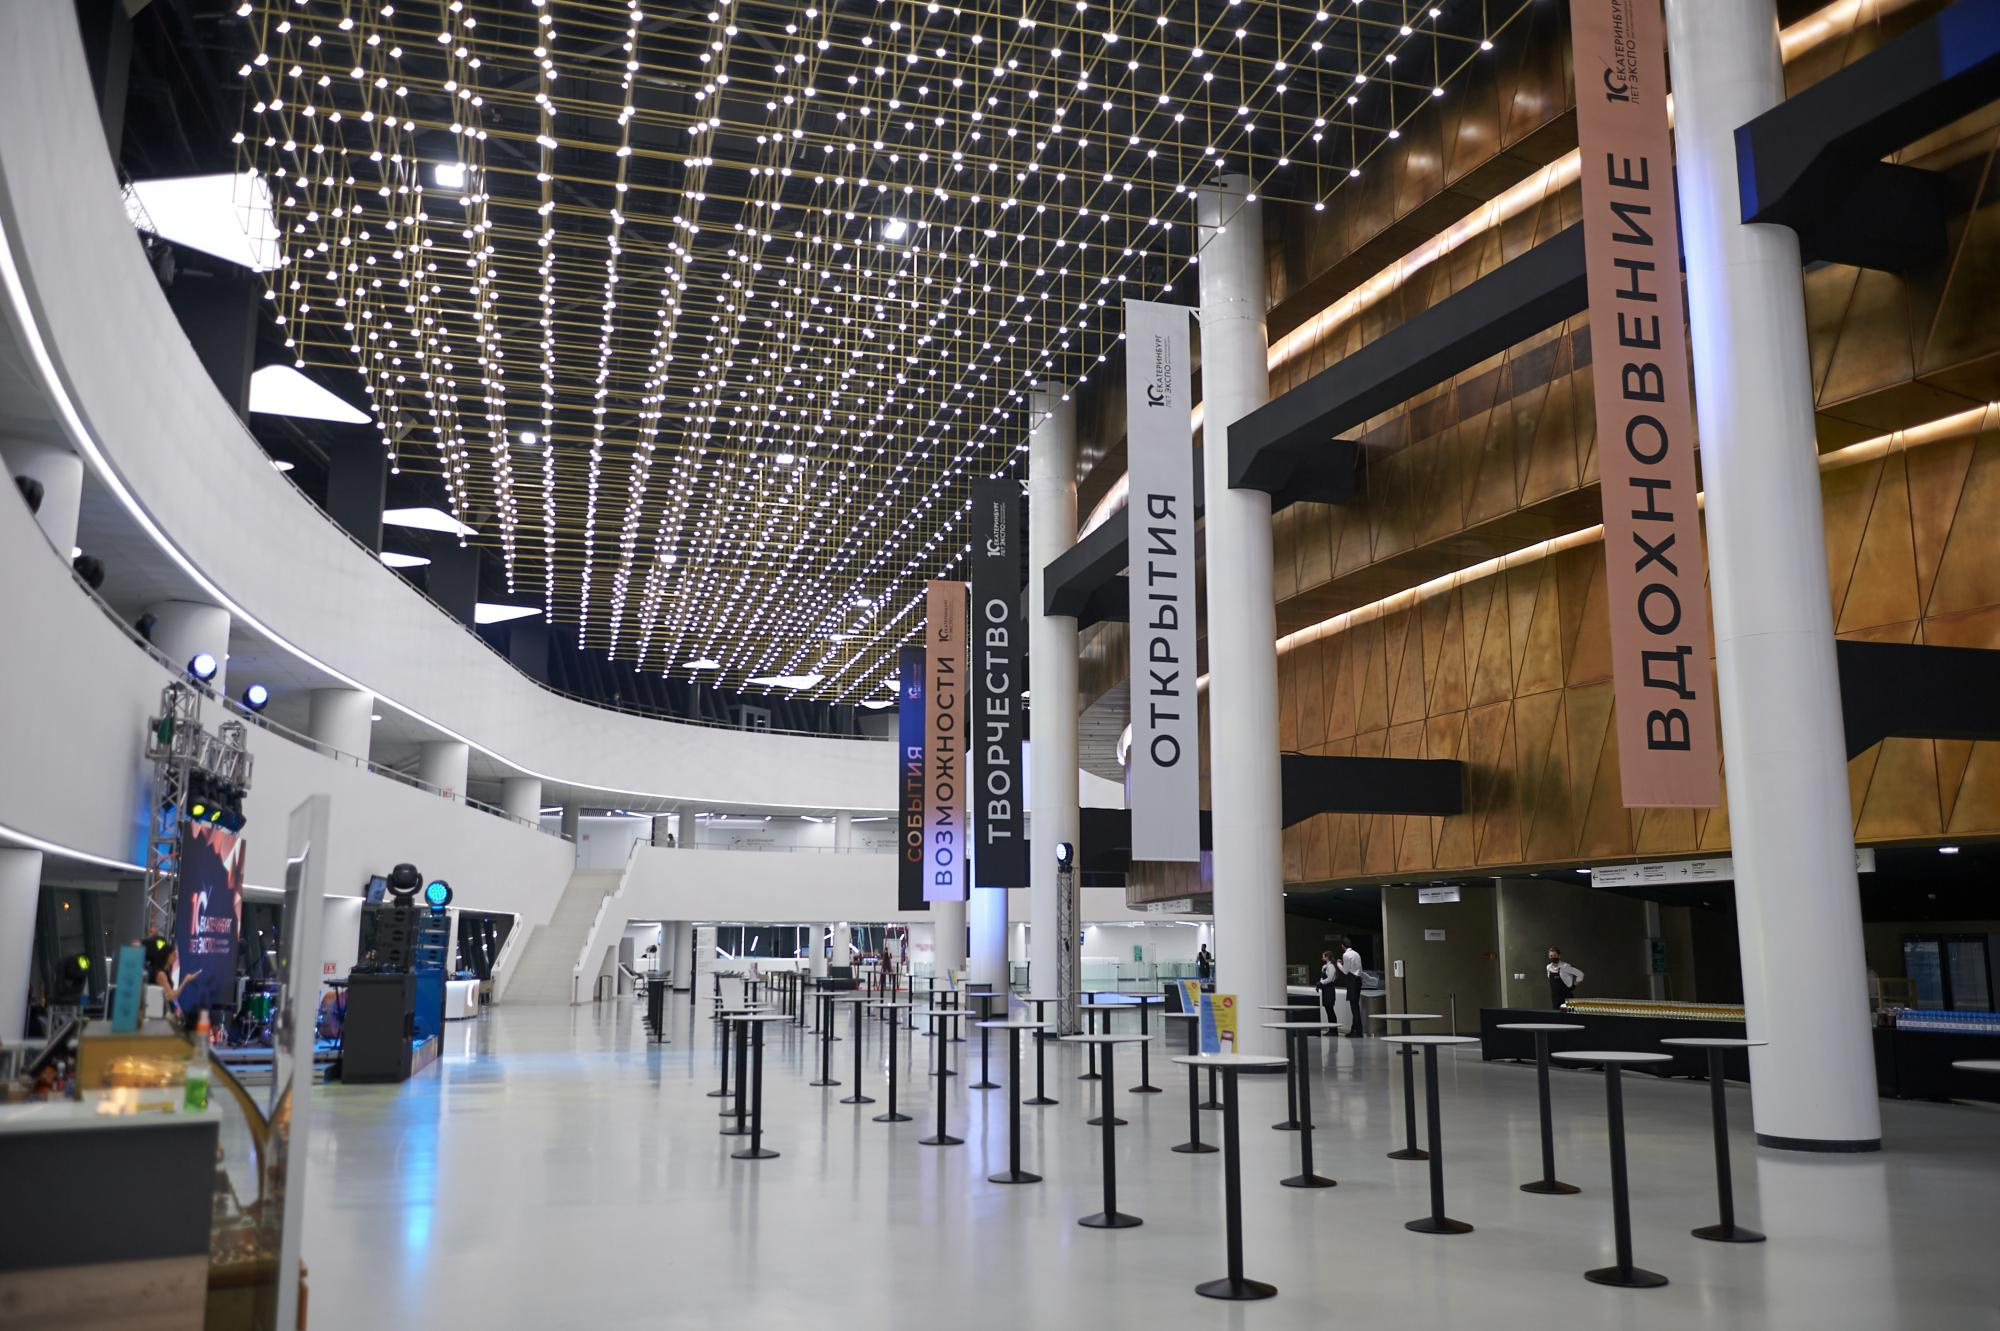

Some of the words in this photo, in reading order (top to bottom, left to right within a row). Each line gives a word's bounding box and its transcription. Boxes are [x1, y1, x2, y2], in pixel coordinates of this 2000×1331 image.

[1626, 39, 1639, 83] ЭКСПО
[1631, 84, 1640, 105] ЛЕТ
[1155, 334, 1164, 393] ЕКАТЕРИНБУРГ
[1164, 364, 1172, 393] ЭКСПО
[1606, 152, 1697, 752] ВДОХНОВЕНИЕ
[1148, 493, 1181, 768] ОТКРЫТИЯ
[935, 657, 954, 886] ВОЗМОЖНОСТИ
[985, 599, 1011, 844] ТВОРЧЕСТВО
[907, 746, 923, 863] СОБЫТИЯ
